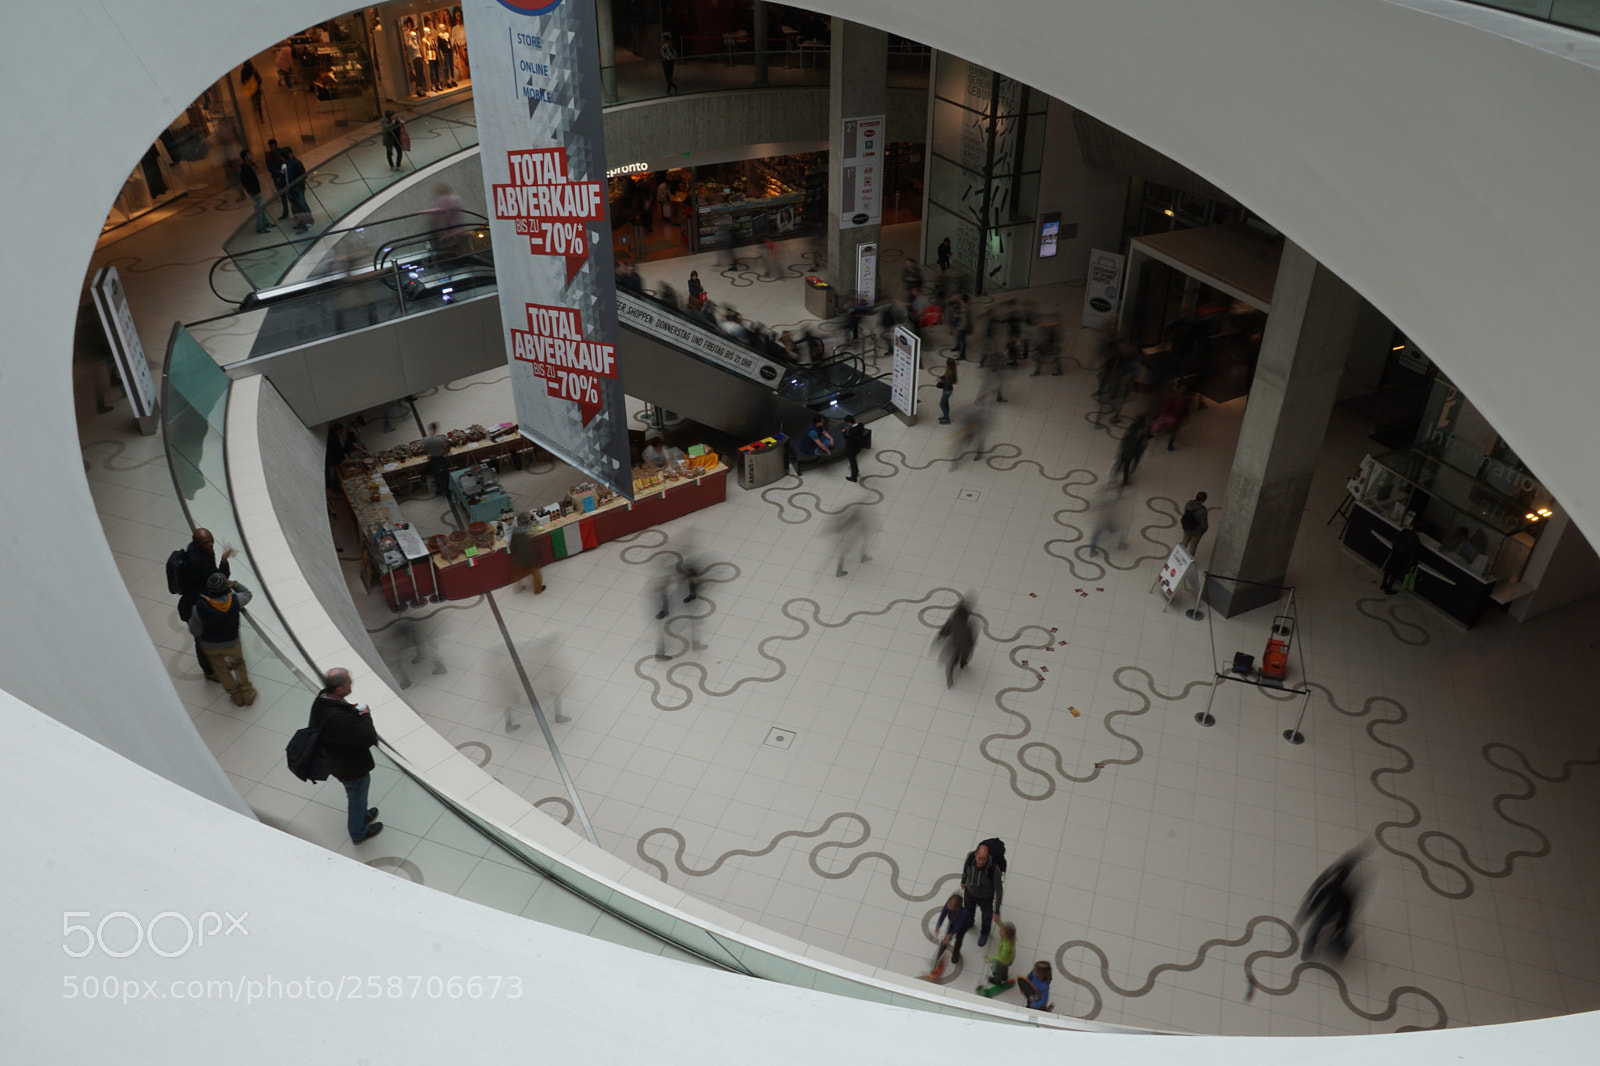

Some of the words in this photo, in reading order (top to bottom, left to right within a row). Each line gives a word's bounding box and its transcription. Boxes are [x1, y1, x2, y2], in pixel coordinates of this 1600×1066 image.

[517, 33, 542, 49] STORE
[520, 60, 549, 77] ONLINE
[523, 86, 552, 104] MOBILE
[510, 151, 567, 186] TOTAL
[496, 184, 601, 218] ABVERKAUF
[515, 219, 529, 233] BIS
[529, 218, 540, 233] ZU
[528, 306, 582, 341] TOTAL
[515, 332, 615, 374] ABVERKAUF
[655, 319, 692, 341] DONNERSTAG
[691, 334, 704, 347] UND
[703, 340, 725, 356] FREITAG
[724, 349, 734, 360] BIS
[734, 353, 741, 363] 21
[741, 356, 753, 368] UHR
[533, 362, 546, 377] BIS
[546, 364, 556, 378] ZU
